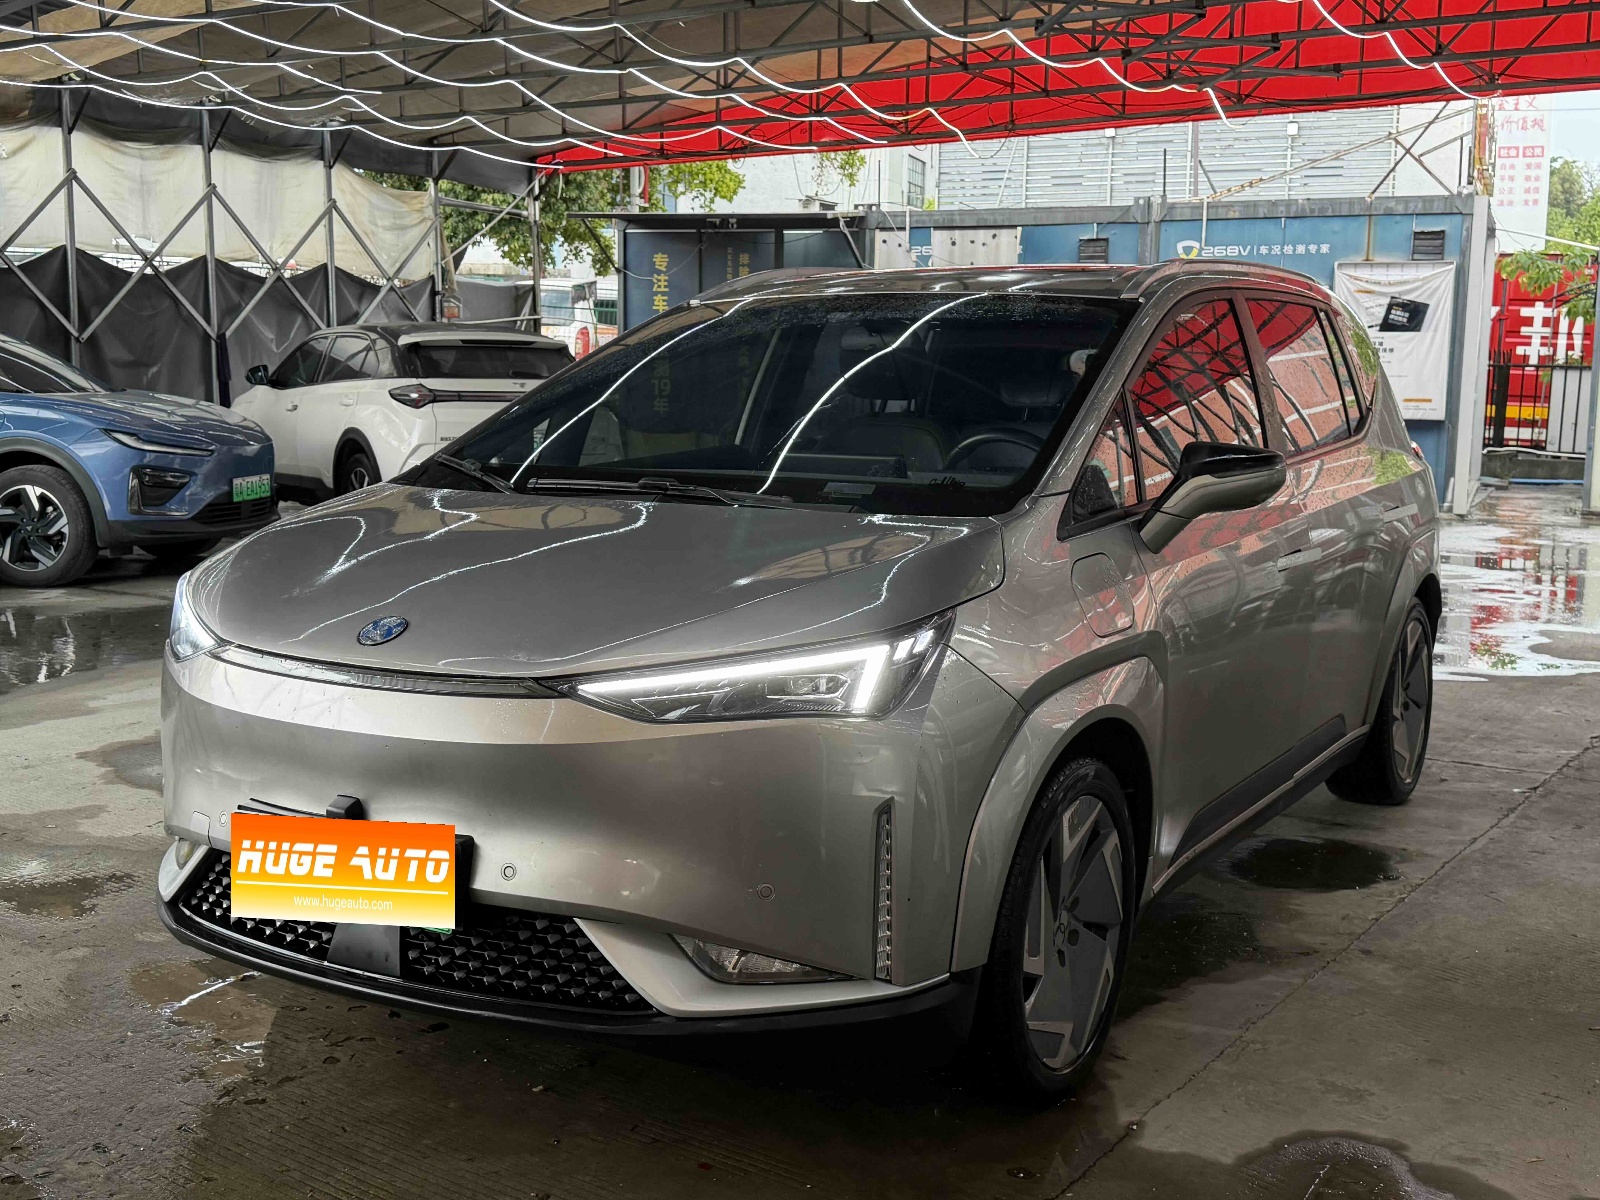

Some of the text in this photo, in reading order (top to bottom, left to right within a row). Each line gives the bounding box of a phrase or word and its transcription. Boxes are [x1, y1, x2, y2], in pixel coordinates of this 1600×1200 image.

[1499, 147, 1543, 157] 社会 公民
[1499, 163, 1516, 171] 自由
[1498, 187, 1514, 195] 公正
[1201, 243, 1331, 257] 268V 车况检测专家
